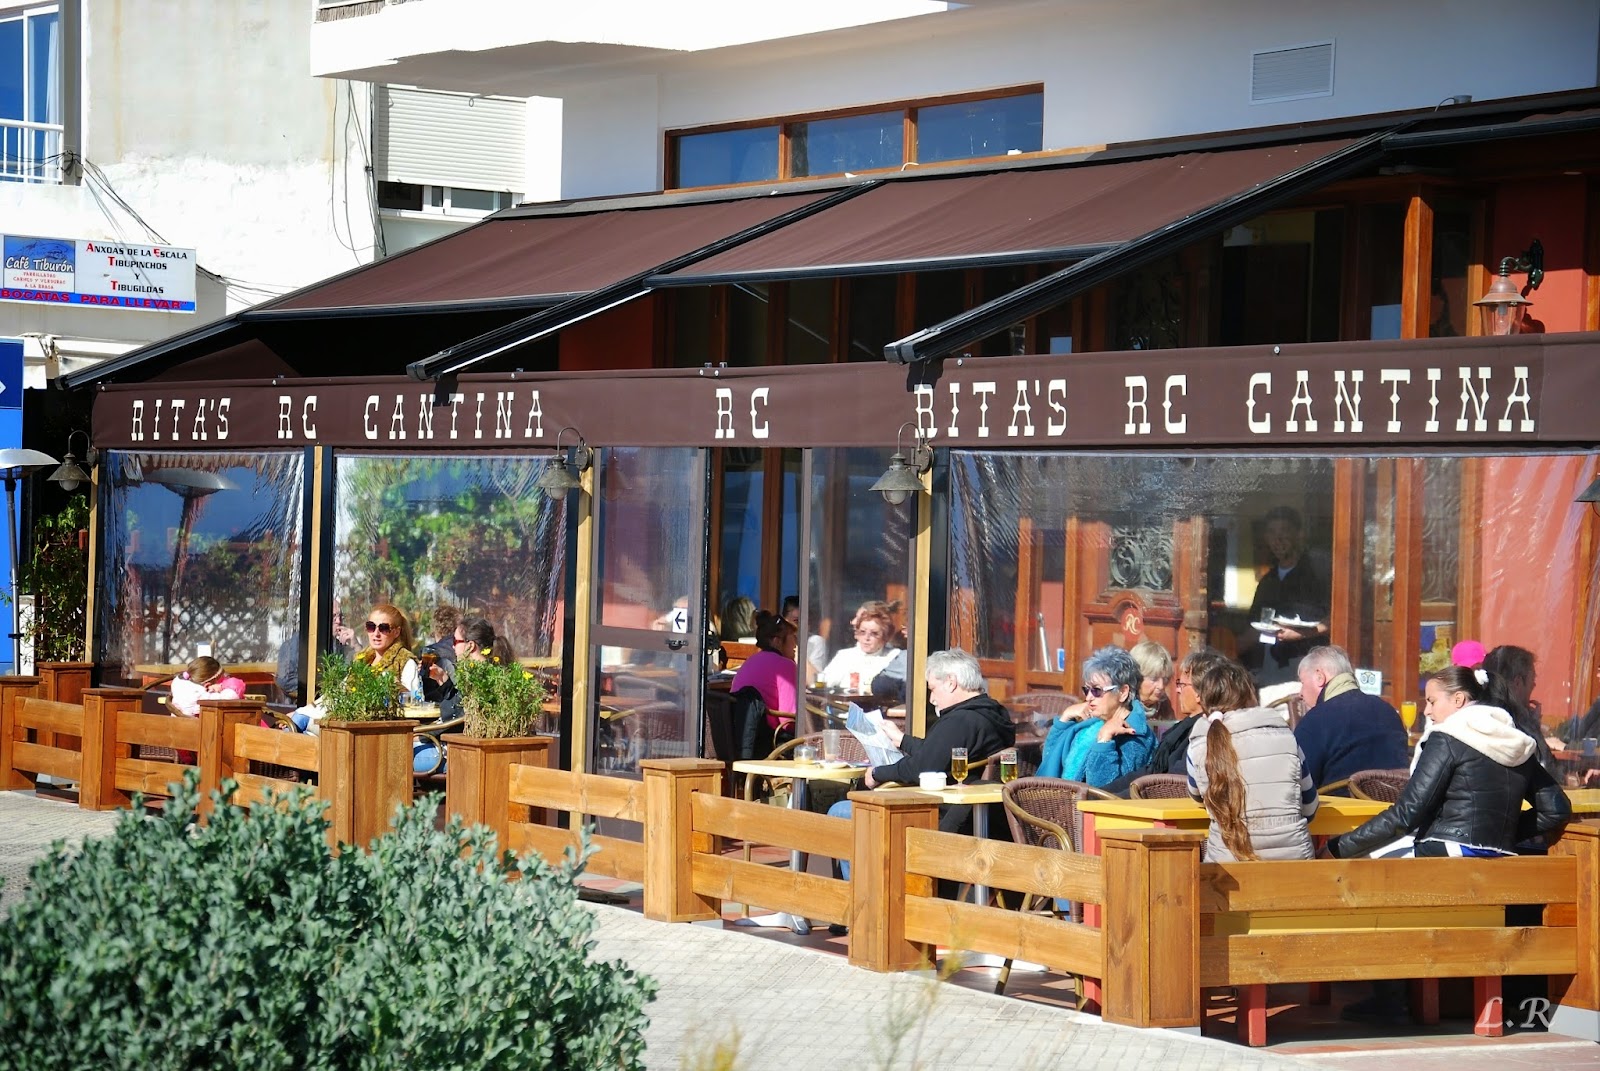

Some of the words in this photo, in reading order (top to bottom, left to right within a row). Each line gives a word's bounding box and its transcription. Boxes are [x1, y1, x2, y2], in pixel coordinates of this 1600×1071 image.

[86, 243, 124, 255] ANXOAS
[127, 248, 138, 256] DE
[141, 249, 151, 257] LA
[153, 248, 187, 259] ESCALA
[6, 256, 29, 269] Café
[33, 258, 73, 272] Tiburón
[108, 256, 167, 270] TIBUPINCHOS
[111, 280, 164, 294] TIBUGILDAS
[1, 289, 69, 302] BOCATAS
[81, 294, 119, 306] PARA
[914, 379, 1066, 438] RITA'S
[1125, 375, 1187, 434] RC
[1246, 366, 1535, 433] CANTINA
[131, 398, 231, 441] RITA'S
[278, 396, 318, 439] RC
[364, 391, 543, 440] CANTINA
[715, 387, 769, 439] RC
